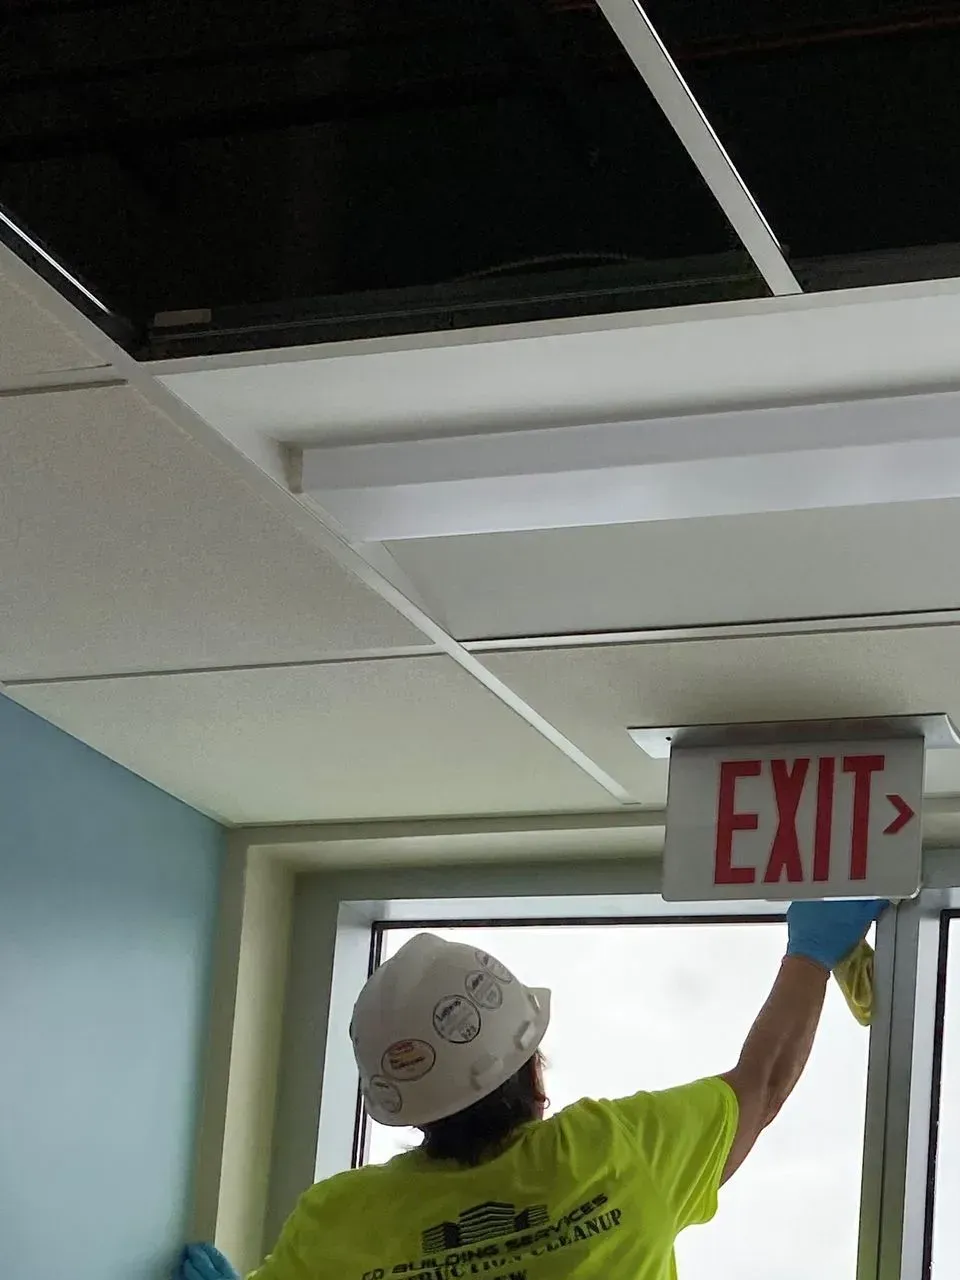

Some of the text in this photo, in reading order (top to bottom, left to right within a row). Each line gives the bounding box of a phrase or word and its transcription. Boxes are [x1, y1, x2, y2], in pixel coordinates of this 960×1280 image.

[714, 755, 885, 885] EXIT
[392, 1244, 500, 1275] BUILDING
[505, 1193, 609, 1253] SERVICES
